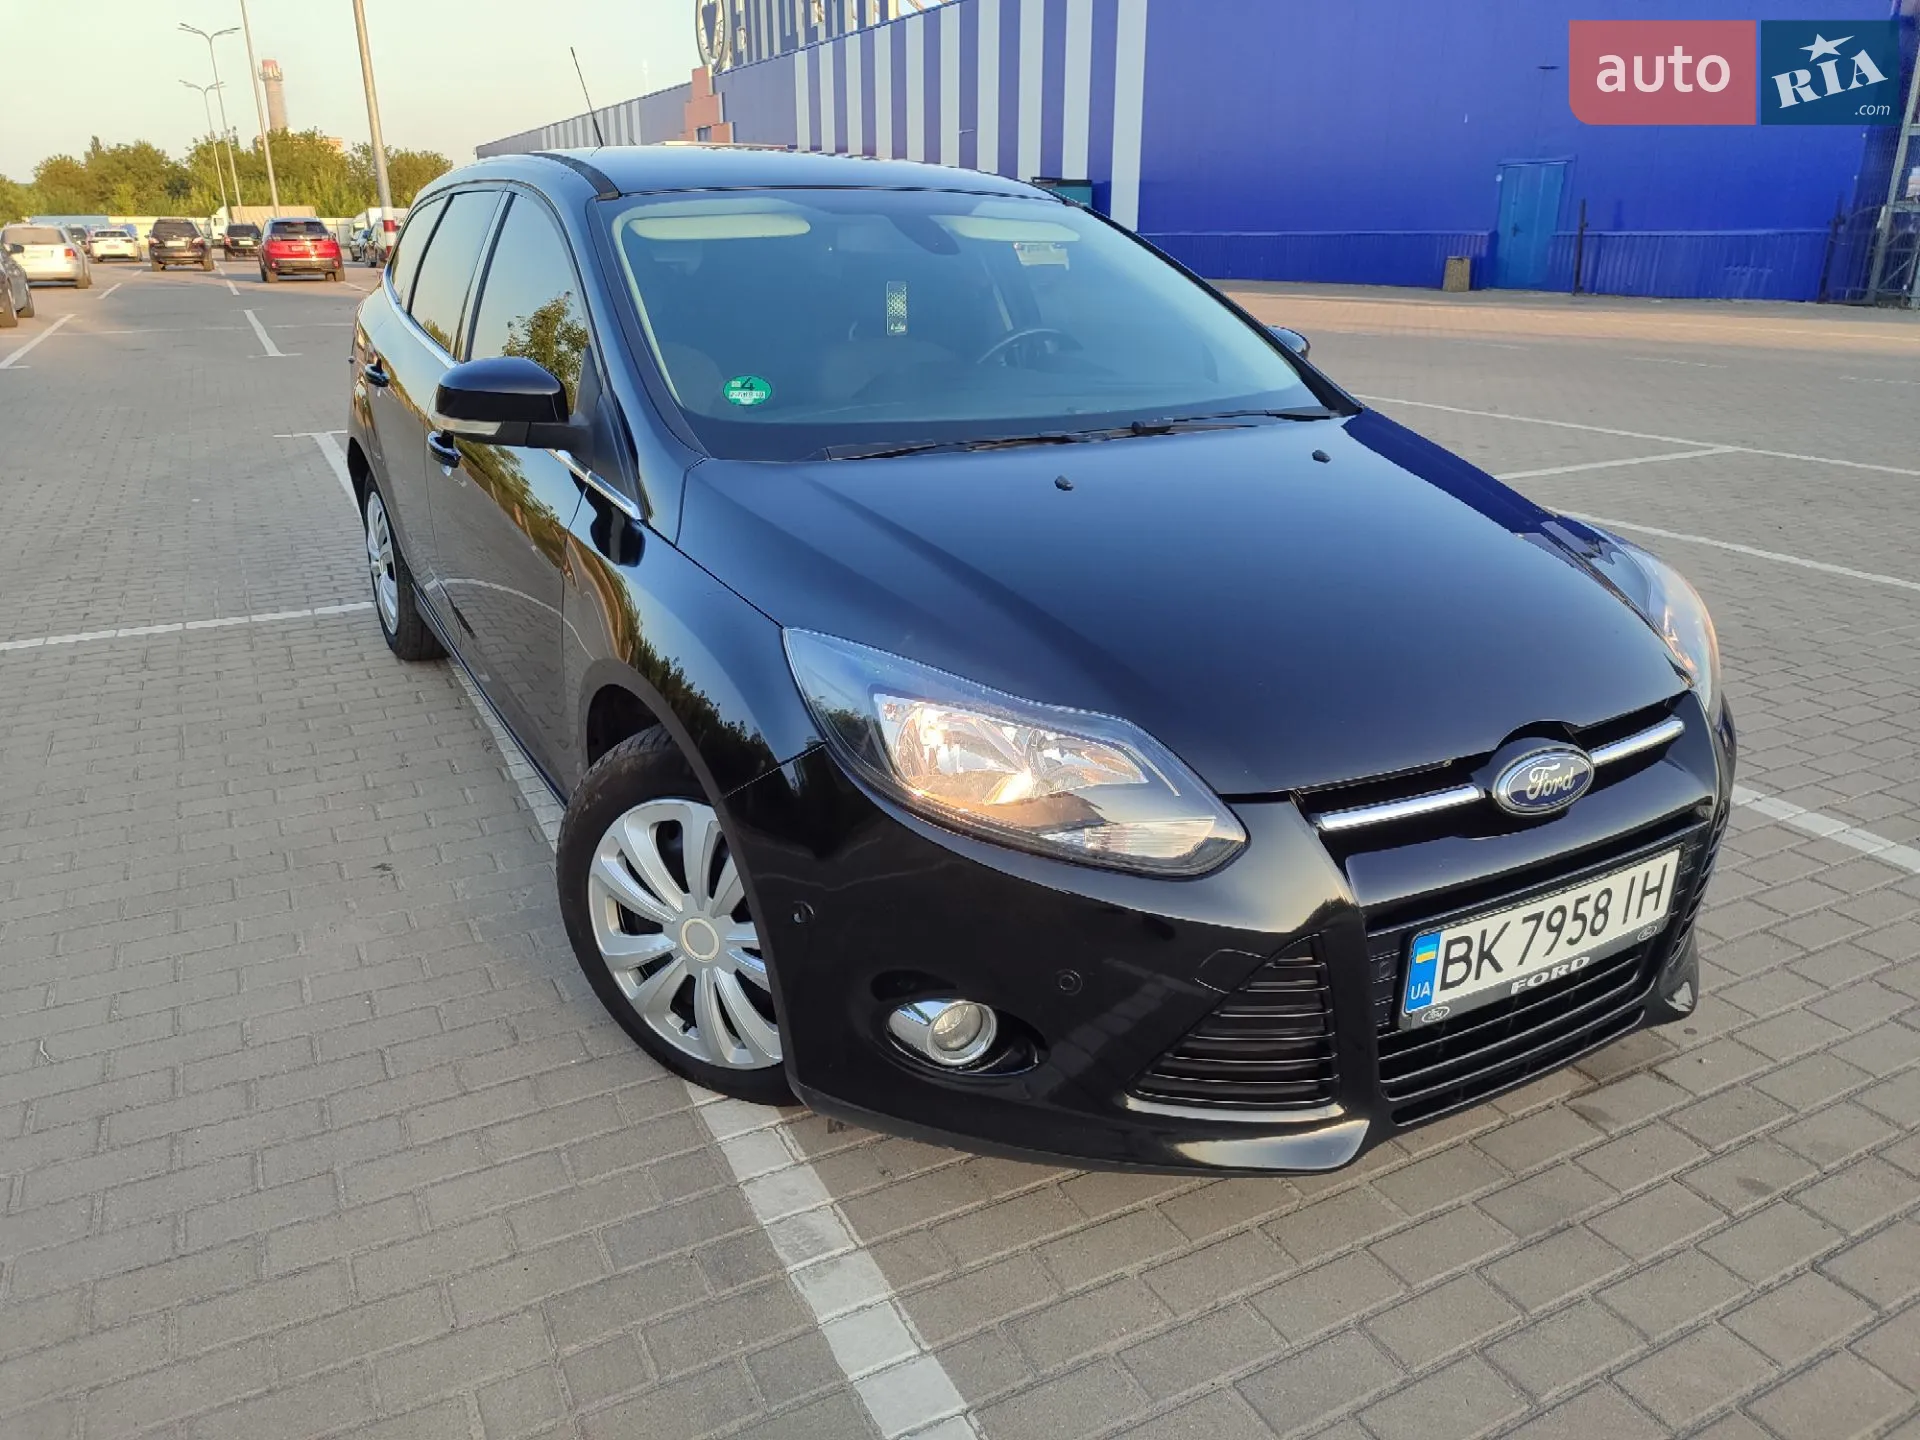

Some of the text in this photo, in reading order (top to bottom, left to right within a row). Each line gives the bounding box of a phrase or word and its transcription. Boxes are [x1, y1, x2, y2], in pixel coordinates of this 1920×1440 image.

[740, 376, 756, 391] 4
[1526, 762, 1576, 800] Ford
[1439, 863, 1668, 992] BK 7958 IH
[1410, 981, 1432, 1000] UA
[1510, 956, 1591, 995] FORD
